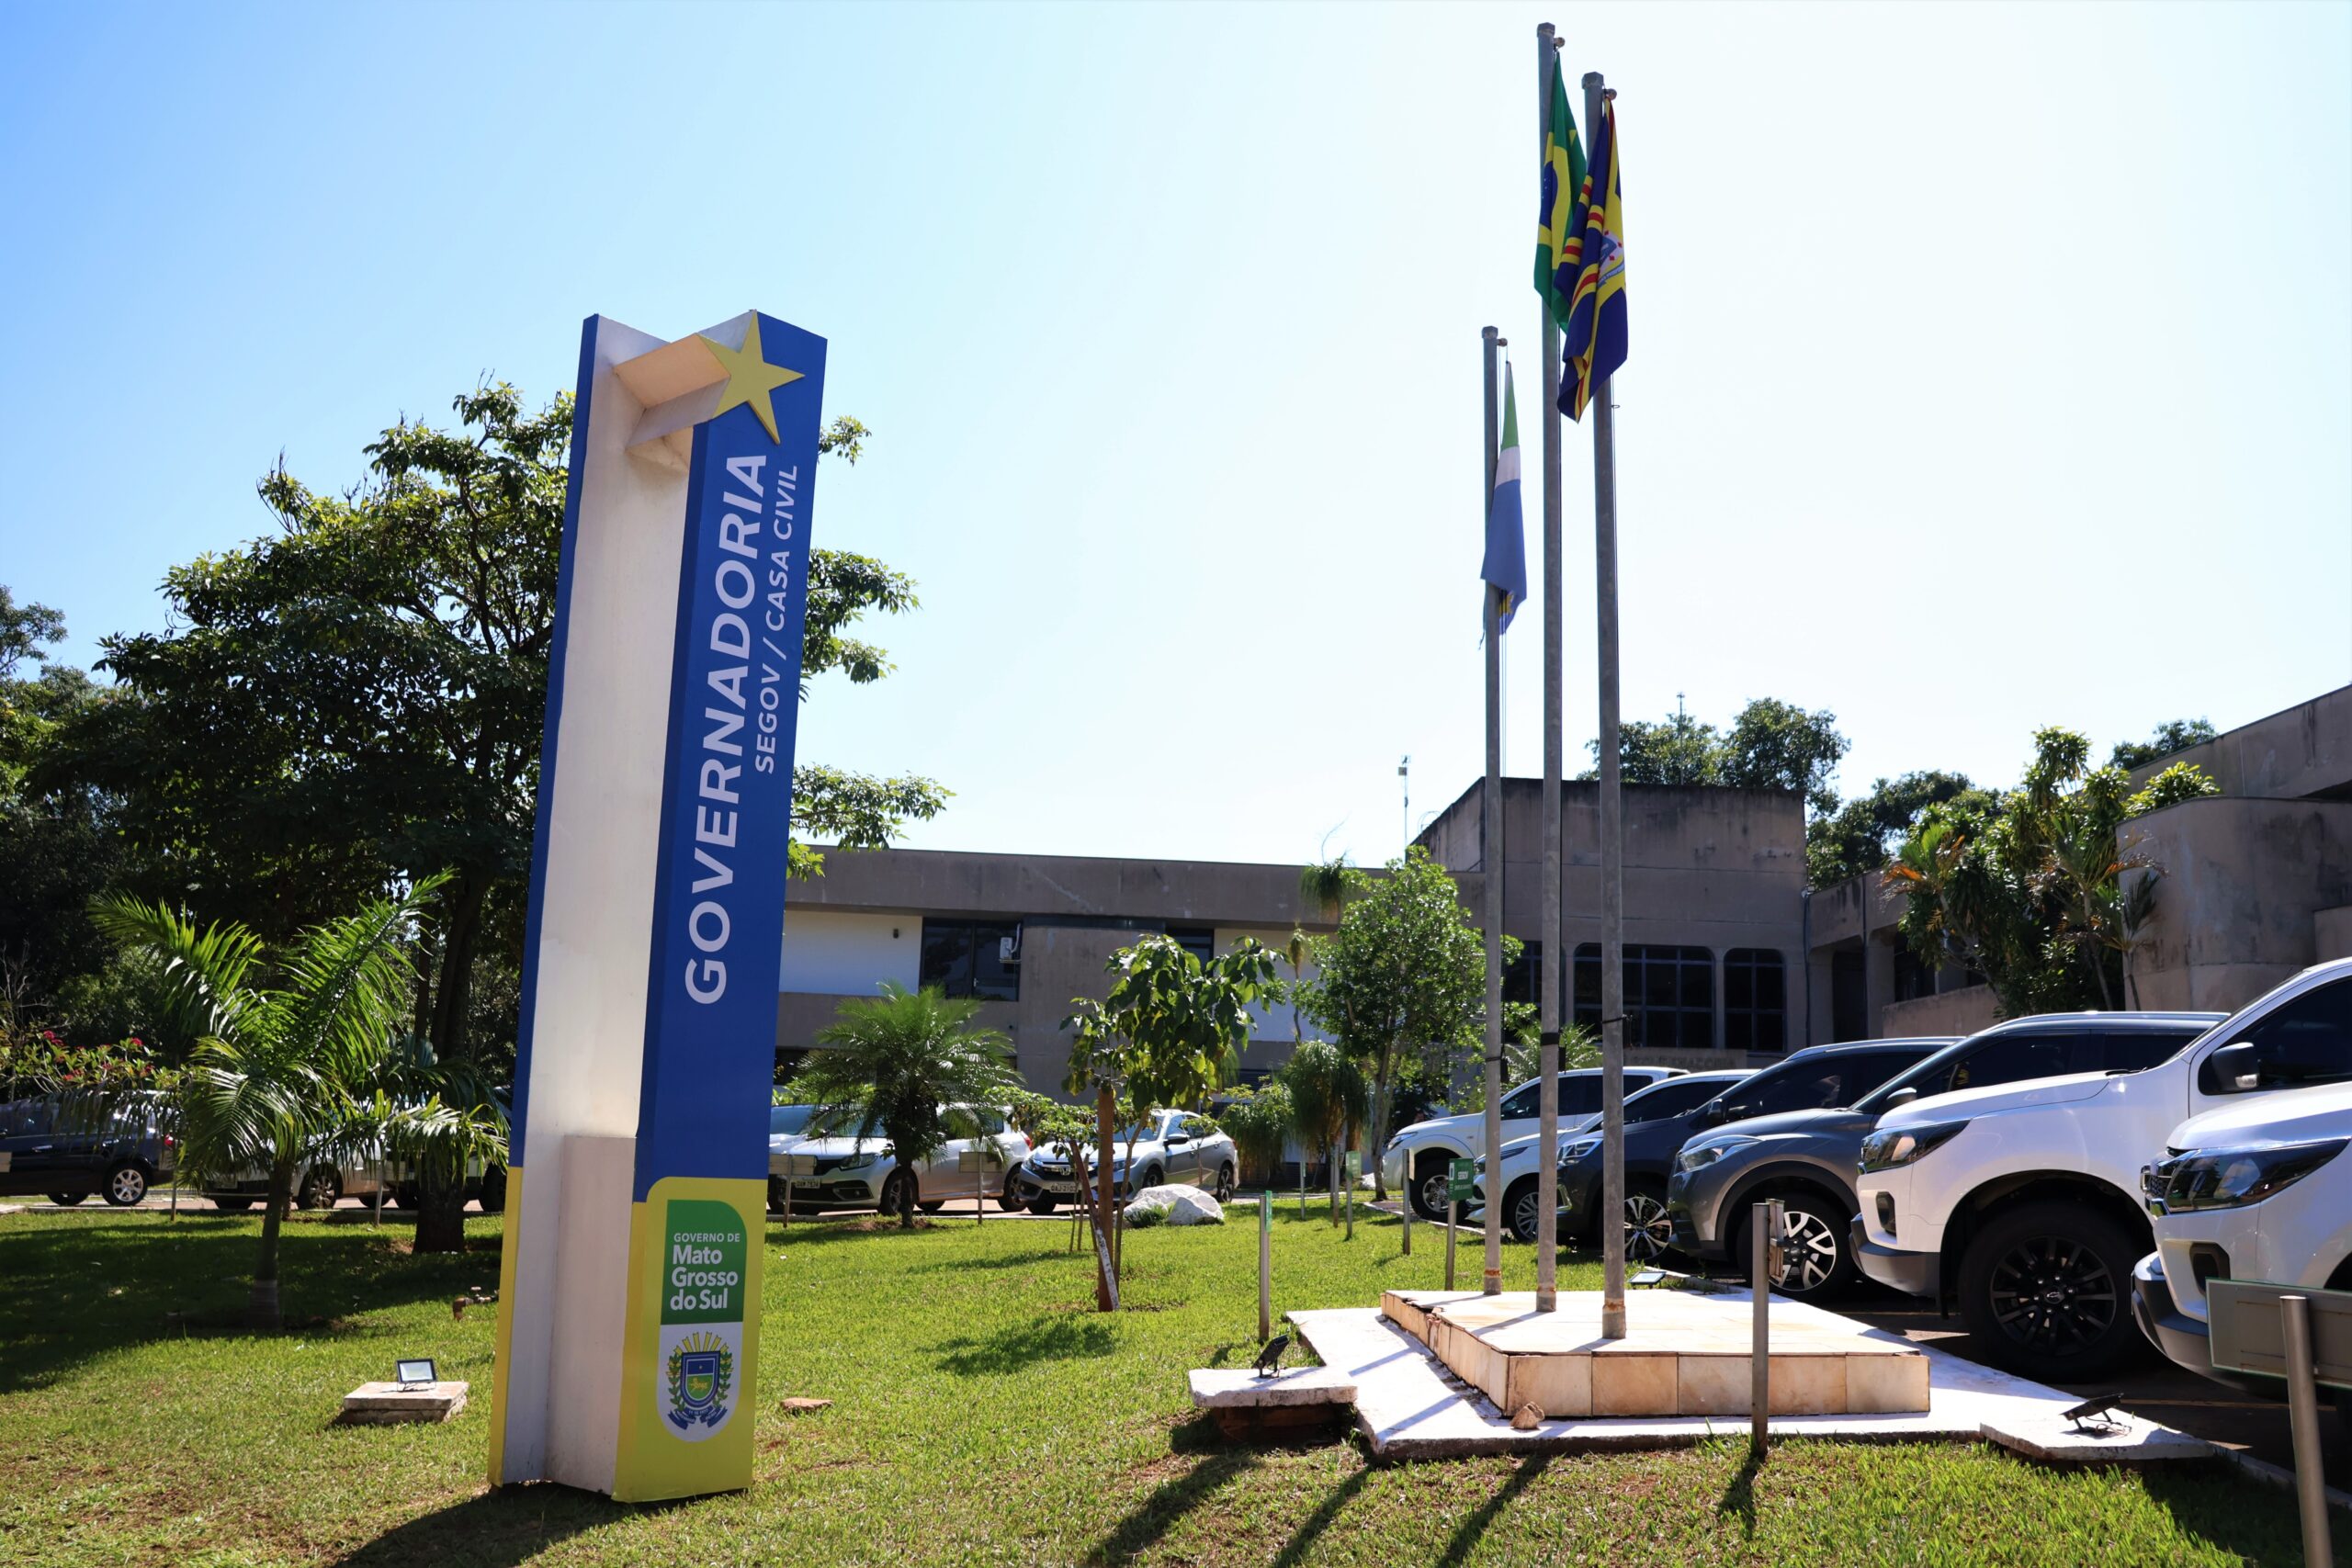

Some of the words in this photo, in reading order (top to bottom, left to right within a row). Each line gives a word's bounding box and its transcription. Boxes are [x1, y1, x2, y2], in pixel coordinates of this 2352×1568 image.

[773, 465, 797, 540] CIVIL
[765, 550, 790, 631] CASA
[684, 455, 767, 1004] GOVERNADORIA
[754, 663, 781, 774] SEGOV
[673, 1233, 725, 1243] GOVERNO
[727, 1233, 741, 1243] DE
[673, 1244, 723, 1265] Mato
[670, 1288, 697, 1311] do
[698, 1287, 729, 1310] Sul
[671, 1266, 739, 1288] Grosso
